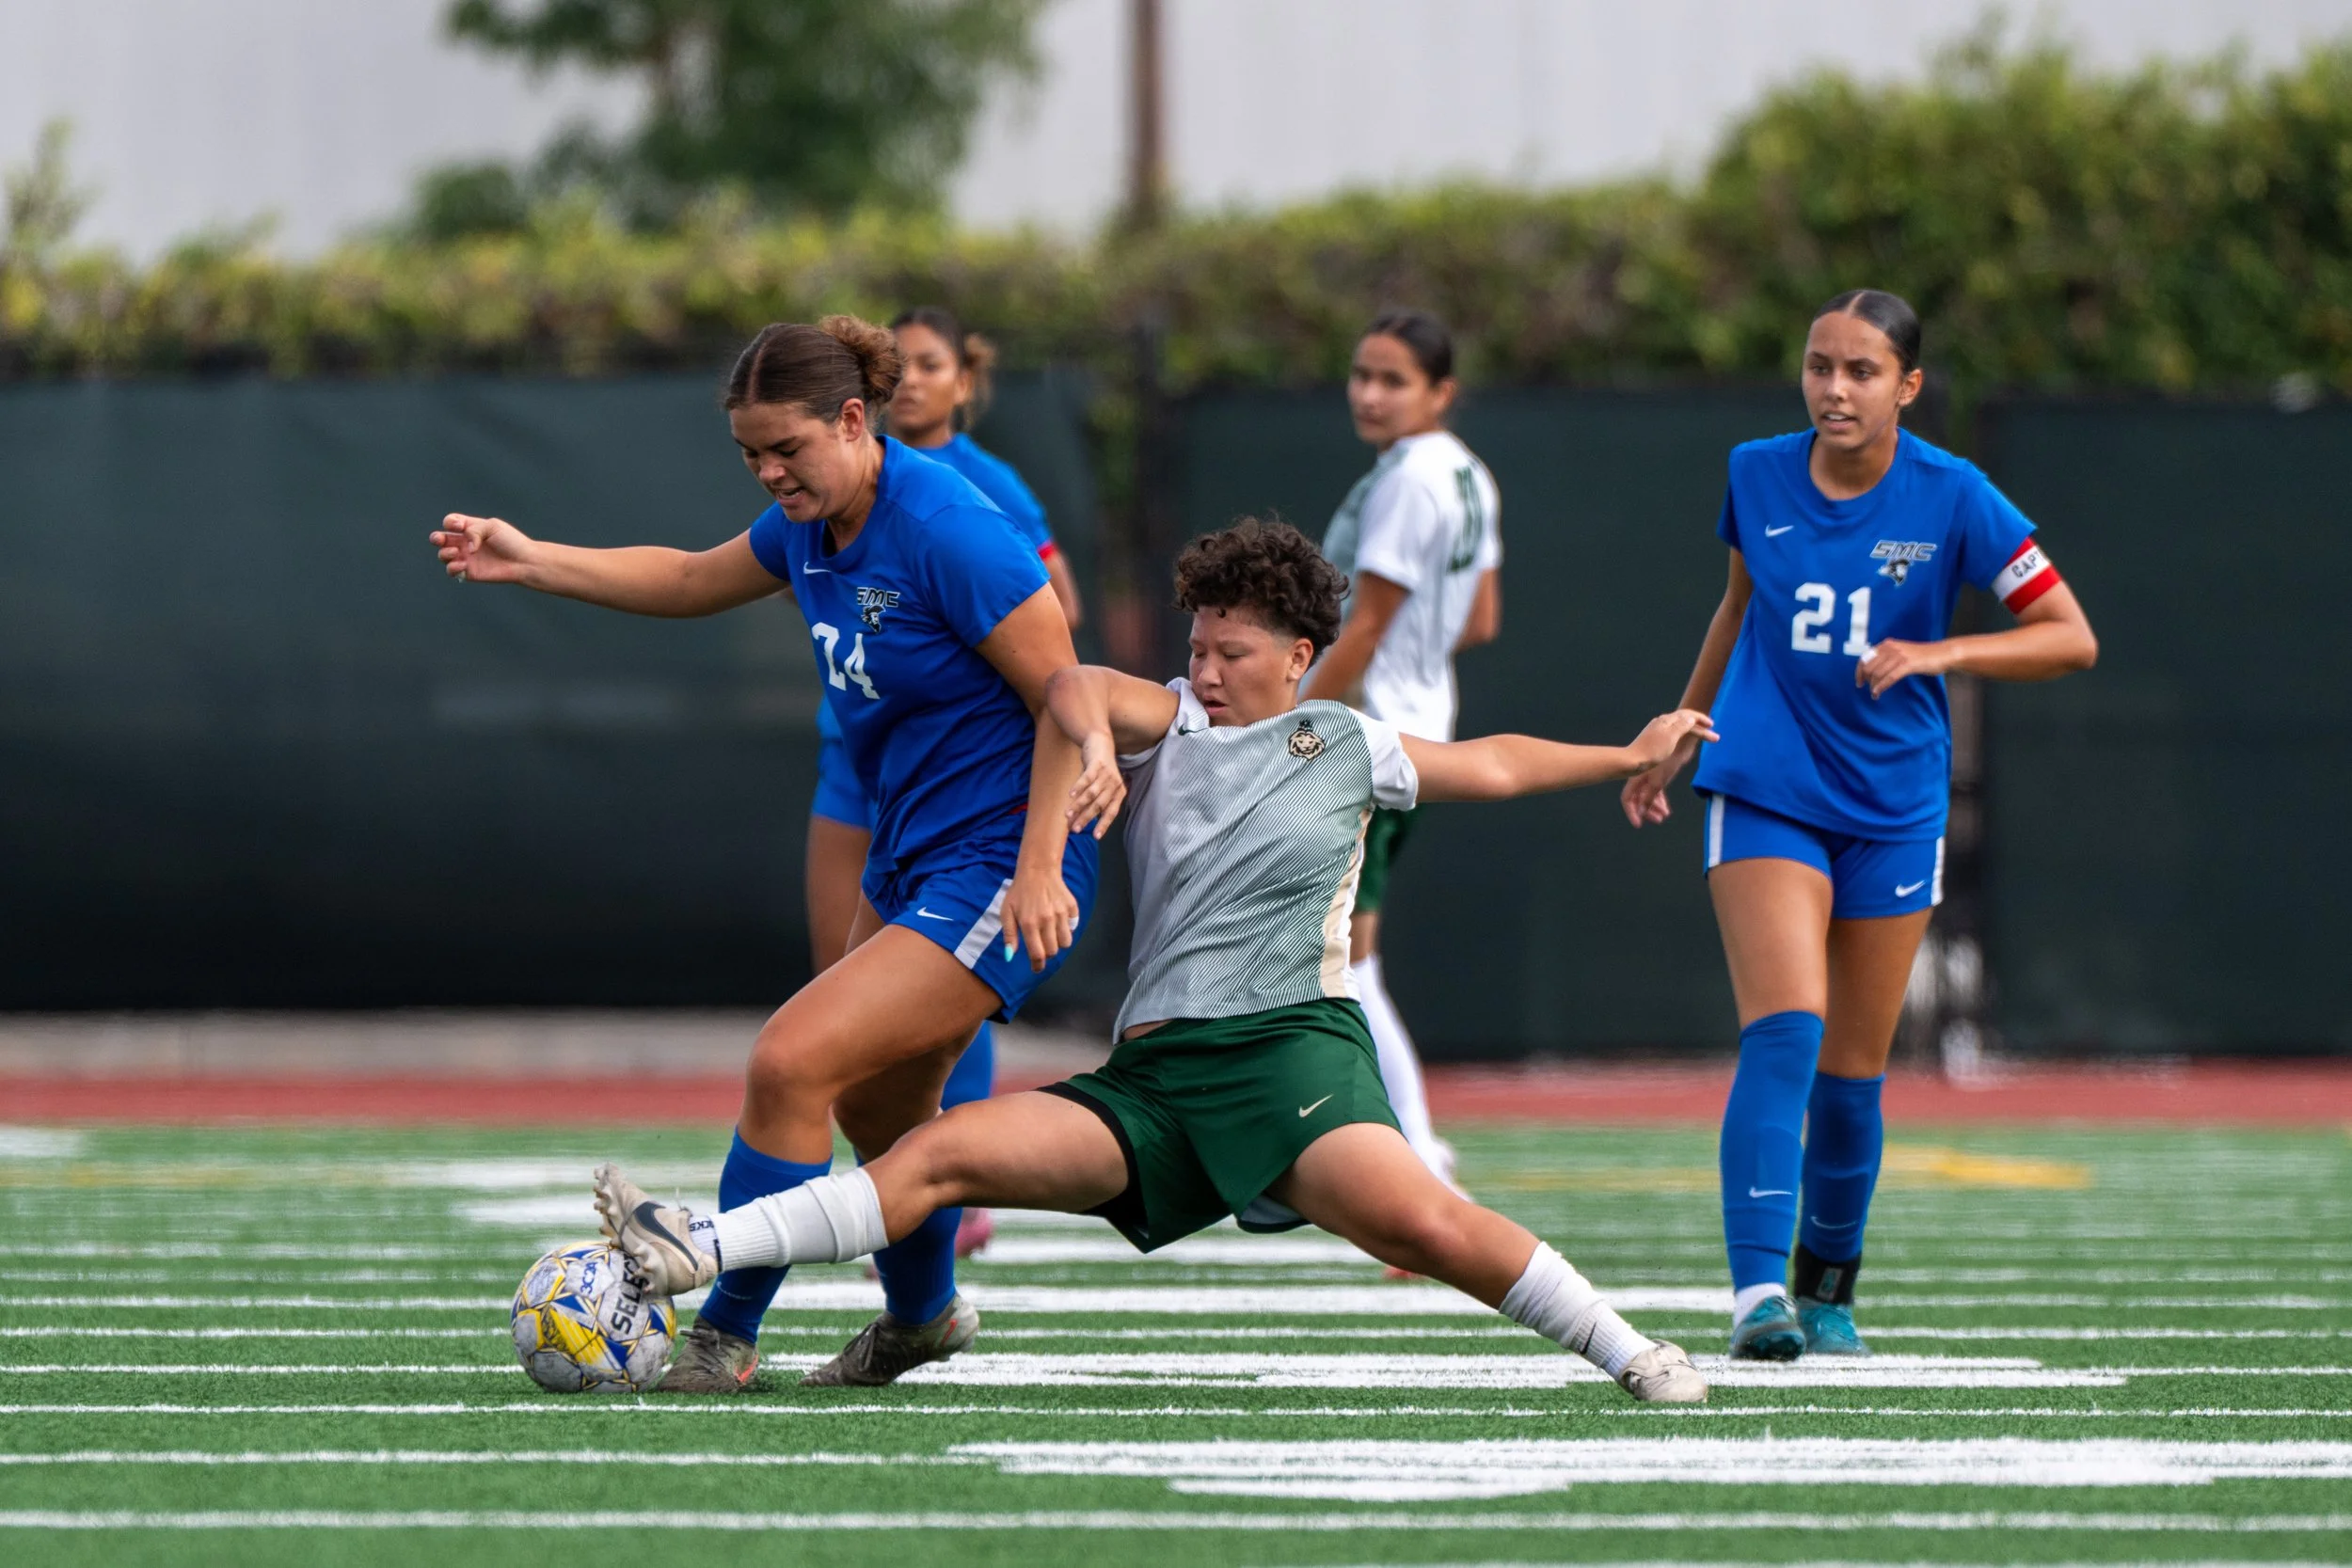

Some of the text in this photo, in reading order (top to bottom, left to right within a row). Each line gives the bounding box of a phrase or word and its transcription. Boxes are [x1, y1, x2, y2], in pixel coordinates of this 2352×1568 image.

[1869, 539, 1938, 562] SMC
[857, 587, 900, 608] SMC
[1791, 581, 1872, 657] 21
[811, 622, 882, 700] 24
